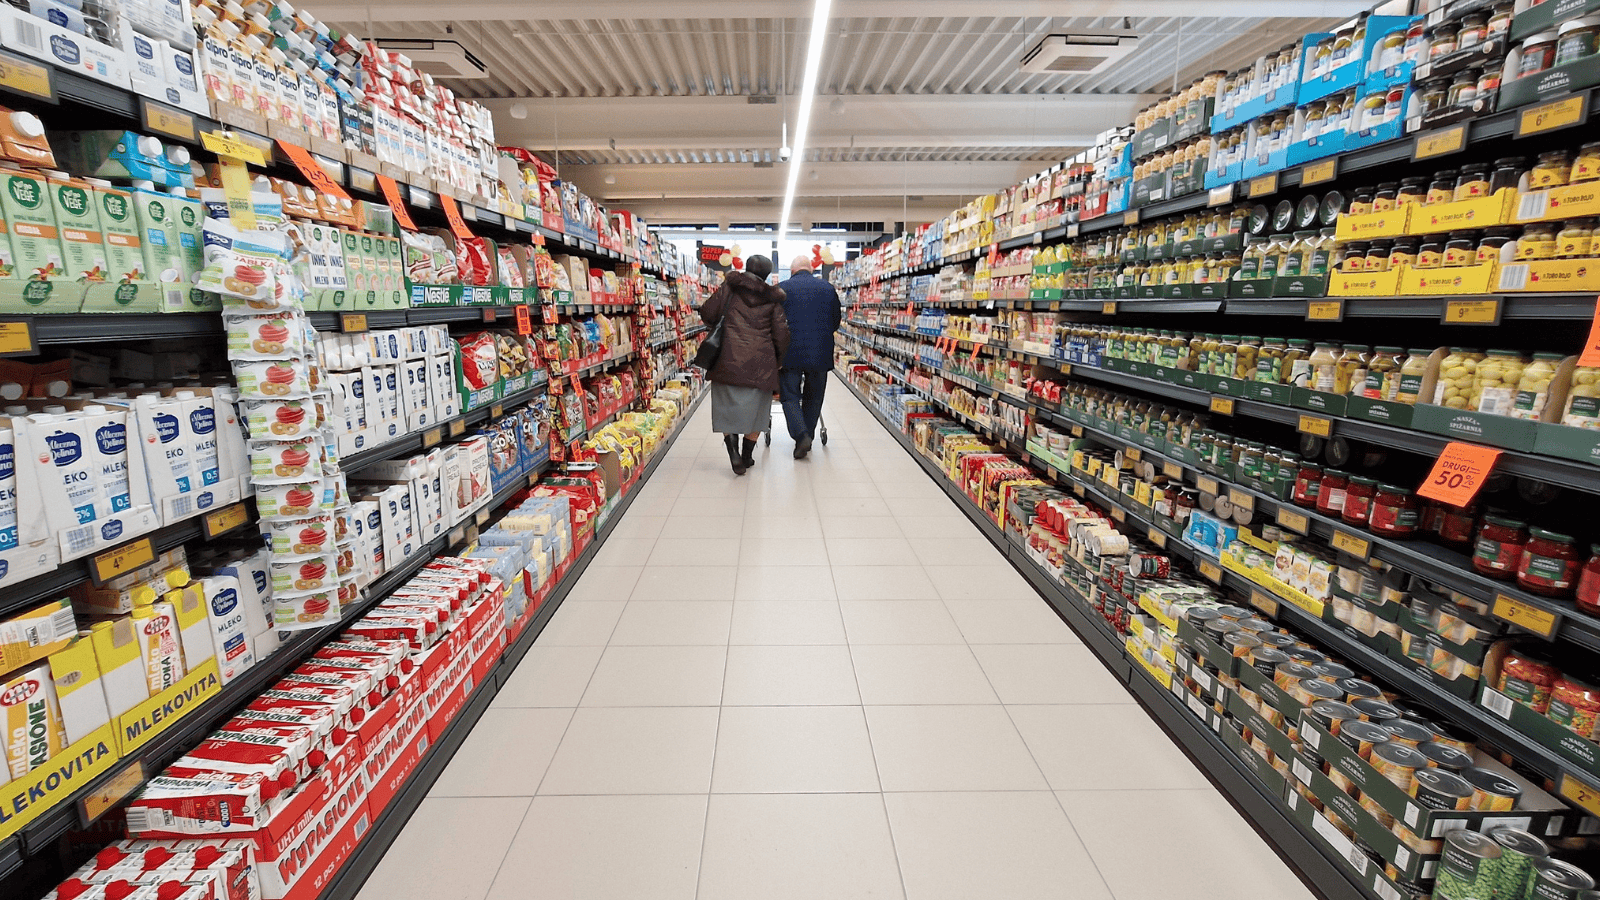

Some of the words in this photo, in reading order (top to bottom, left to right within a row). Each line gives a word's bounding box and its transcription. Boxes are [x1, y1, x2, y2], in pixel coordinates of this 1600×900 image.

[206, 40, 229, 58] alpro
[230, 51, 253, 70] alpro
[1536, 114, 1542, 126] 6
[222, 143, 231, 153] 3
[206, 233, 228, 244] 100
[1459, 308, 1464, 318] 9
[1456, 416, 1477, 425] NASZA
[1449, 421, 1482, 433] SPIŻARNIA
[1442, 461, 1470, 473] DRUGI
[63, 470, 88, 485] EKO
[113, 557, 120, 569] 4
[1508, 607, 1515, 617] 5
[218, 614, 242, 633] MLEKO
[126, 671, 218, 741] MLEKOVITA
[9, 727, 27, 777] mleko
[1577, 790, 1584, 801] 2
[277, 831, 296, 853] UHT
[296, 808, 315, 832] milk
[313, 875, 323, 889] 12
[322, 862, 335, 881] pcs
